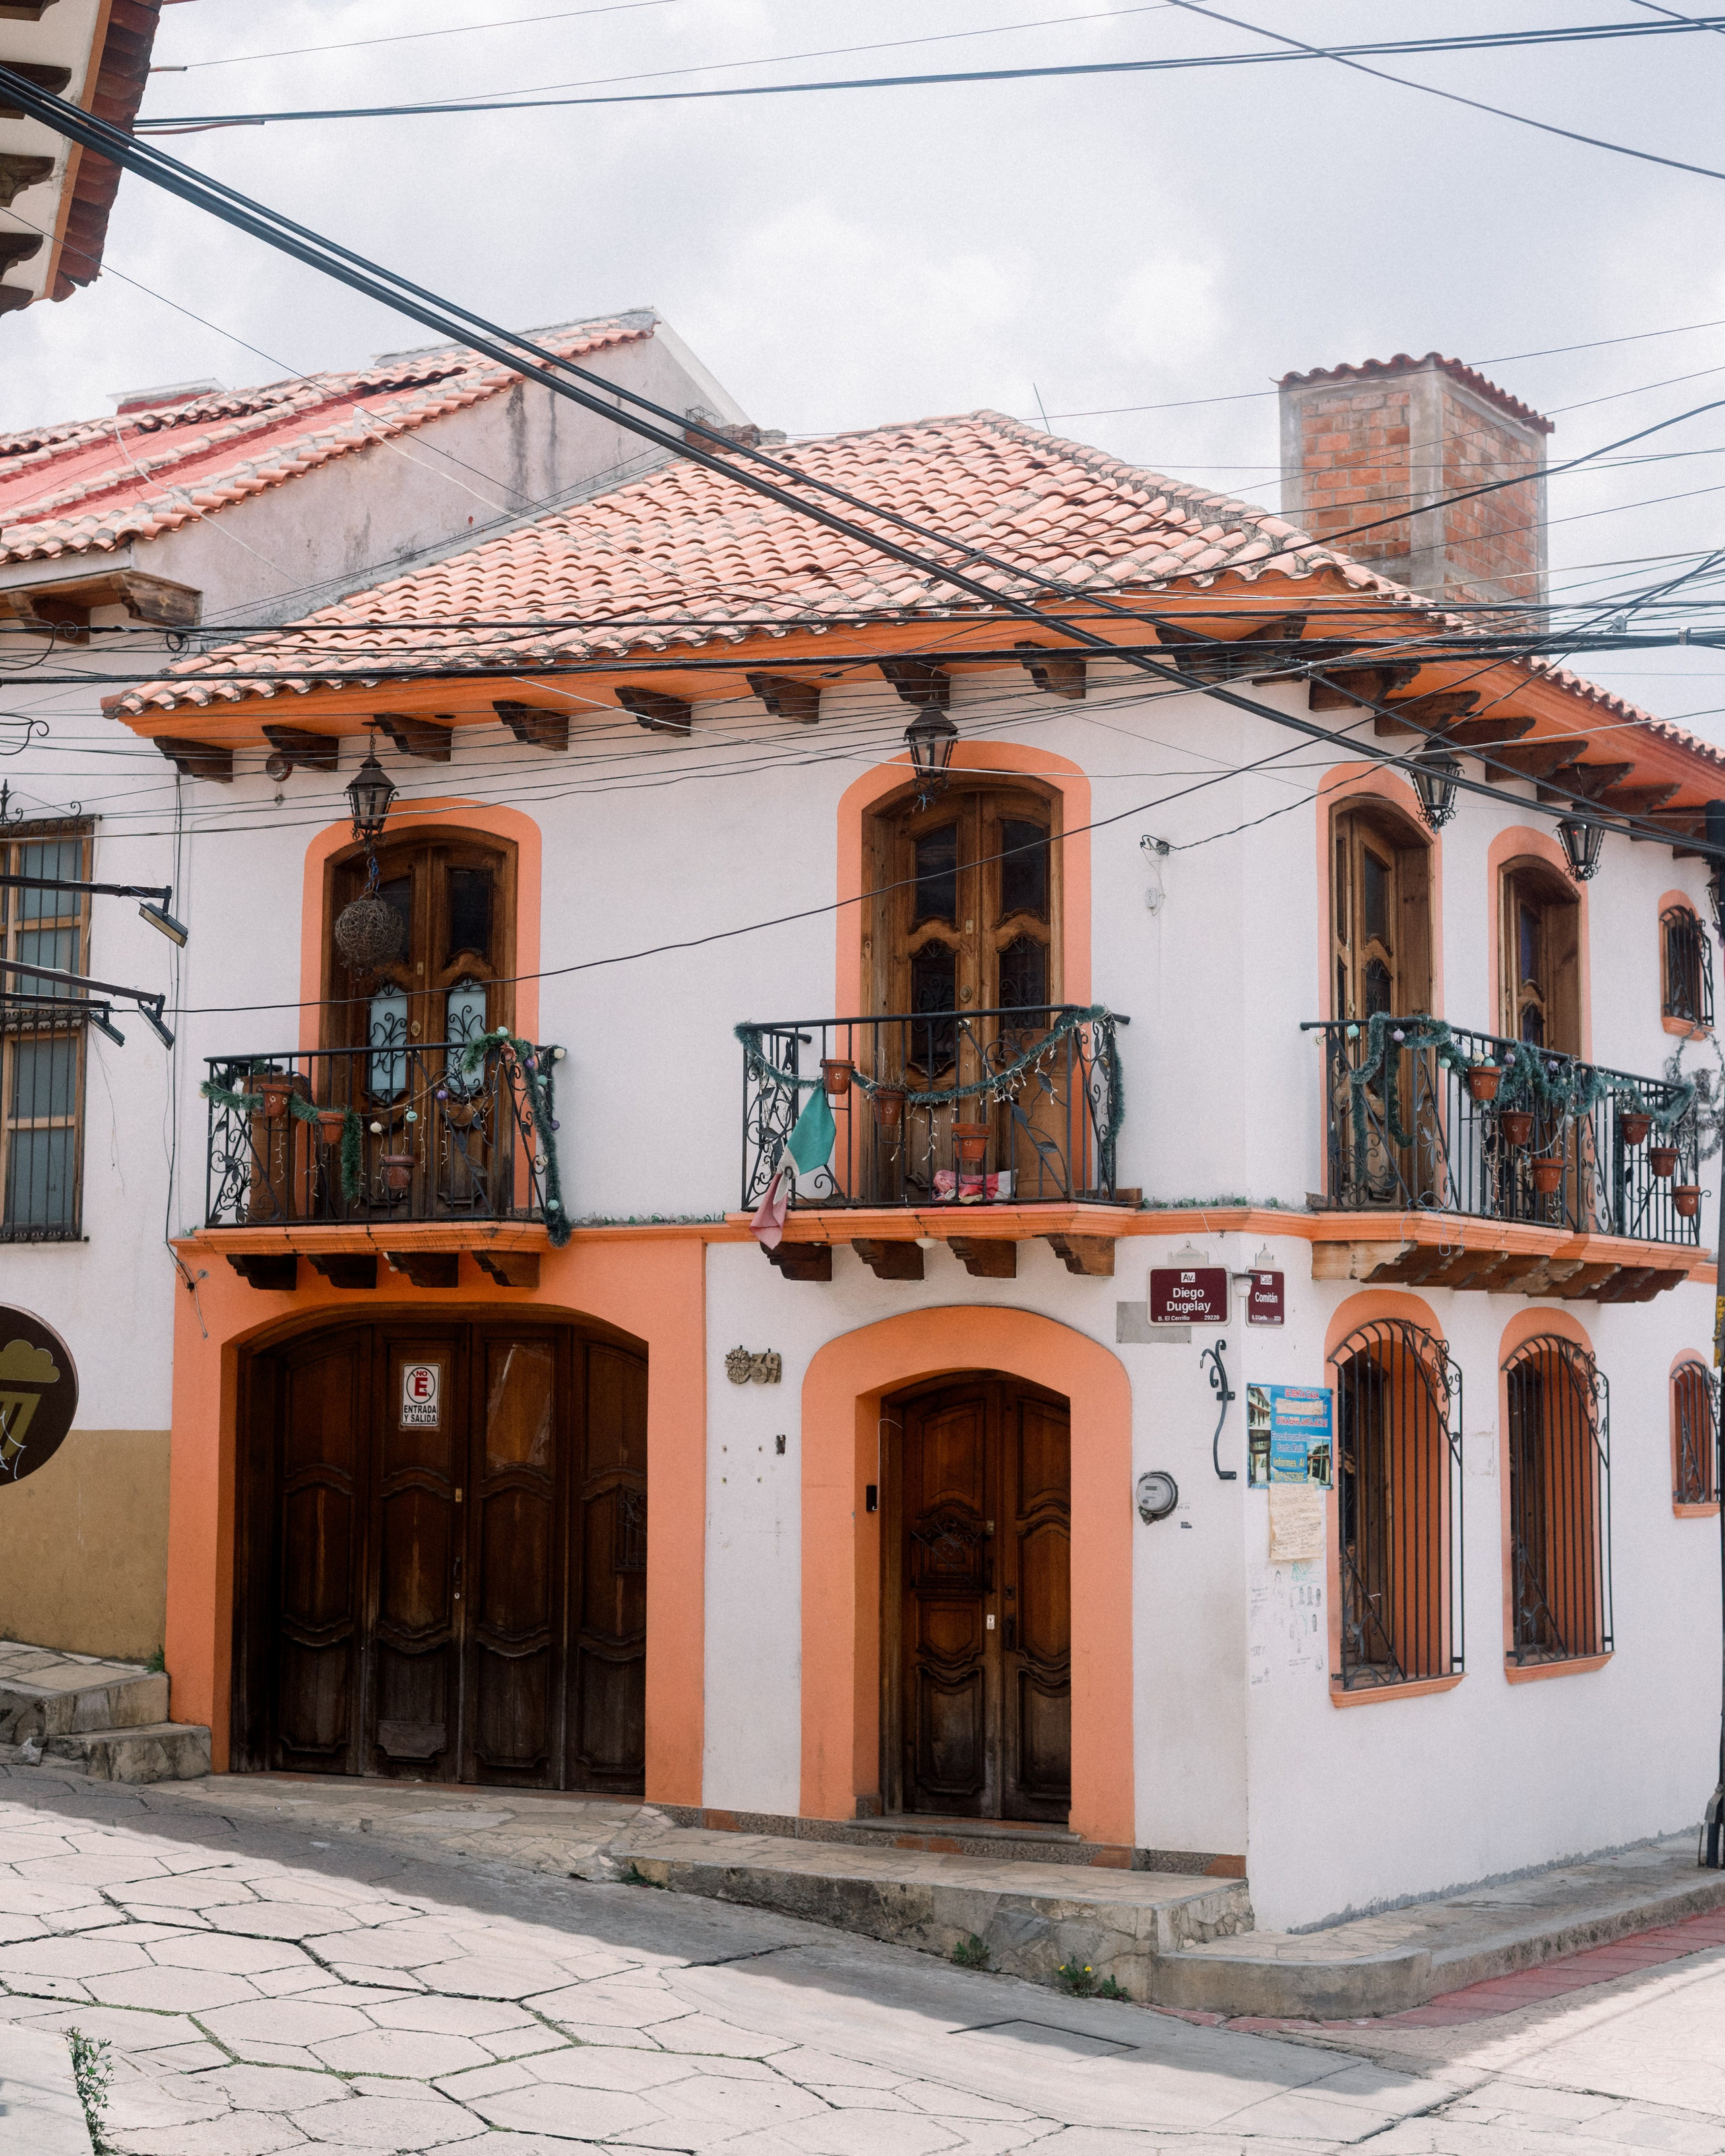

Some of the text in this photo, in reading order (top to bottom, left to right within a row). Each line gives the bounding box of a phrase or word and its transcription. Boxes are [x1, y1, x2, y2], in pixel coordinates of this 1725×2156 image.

[1183, 1273, 1195, 1281] Av.
[1261, 1275, 1272, 1284] Calle
[1172, 1287, 1205, 1300] Diego
[1255, 1292, 1278, 1304] Comitán
[1166, 1300, 1211, 1314] Dugelay
[414, 1377, 428, 1397] E
[1284, 1389, 1319, 1399] SE RENTA CASA
[404, 1405, 437, 1414] ENTRADA
[404, 1414, 437, 1423] Y SALIDA
[1276, 1416, 1289, 1426] OTRA
[1272, 1431, 1311, 1442] Fraccionamiento
[1277, 1442, 1290, 1453] Santa
